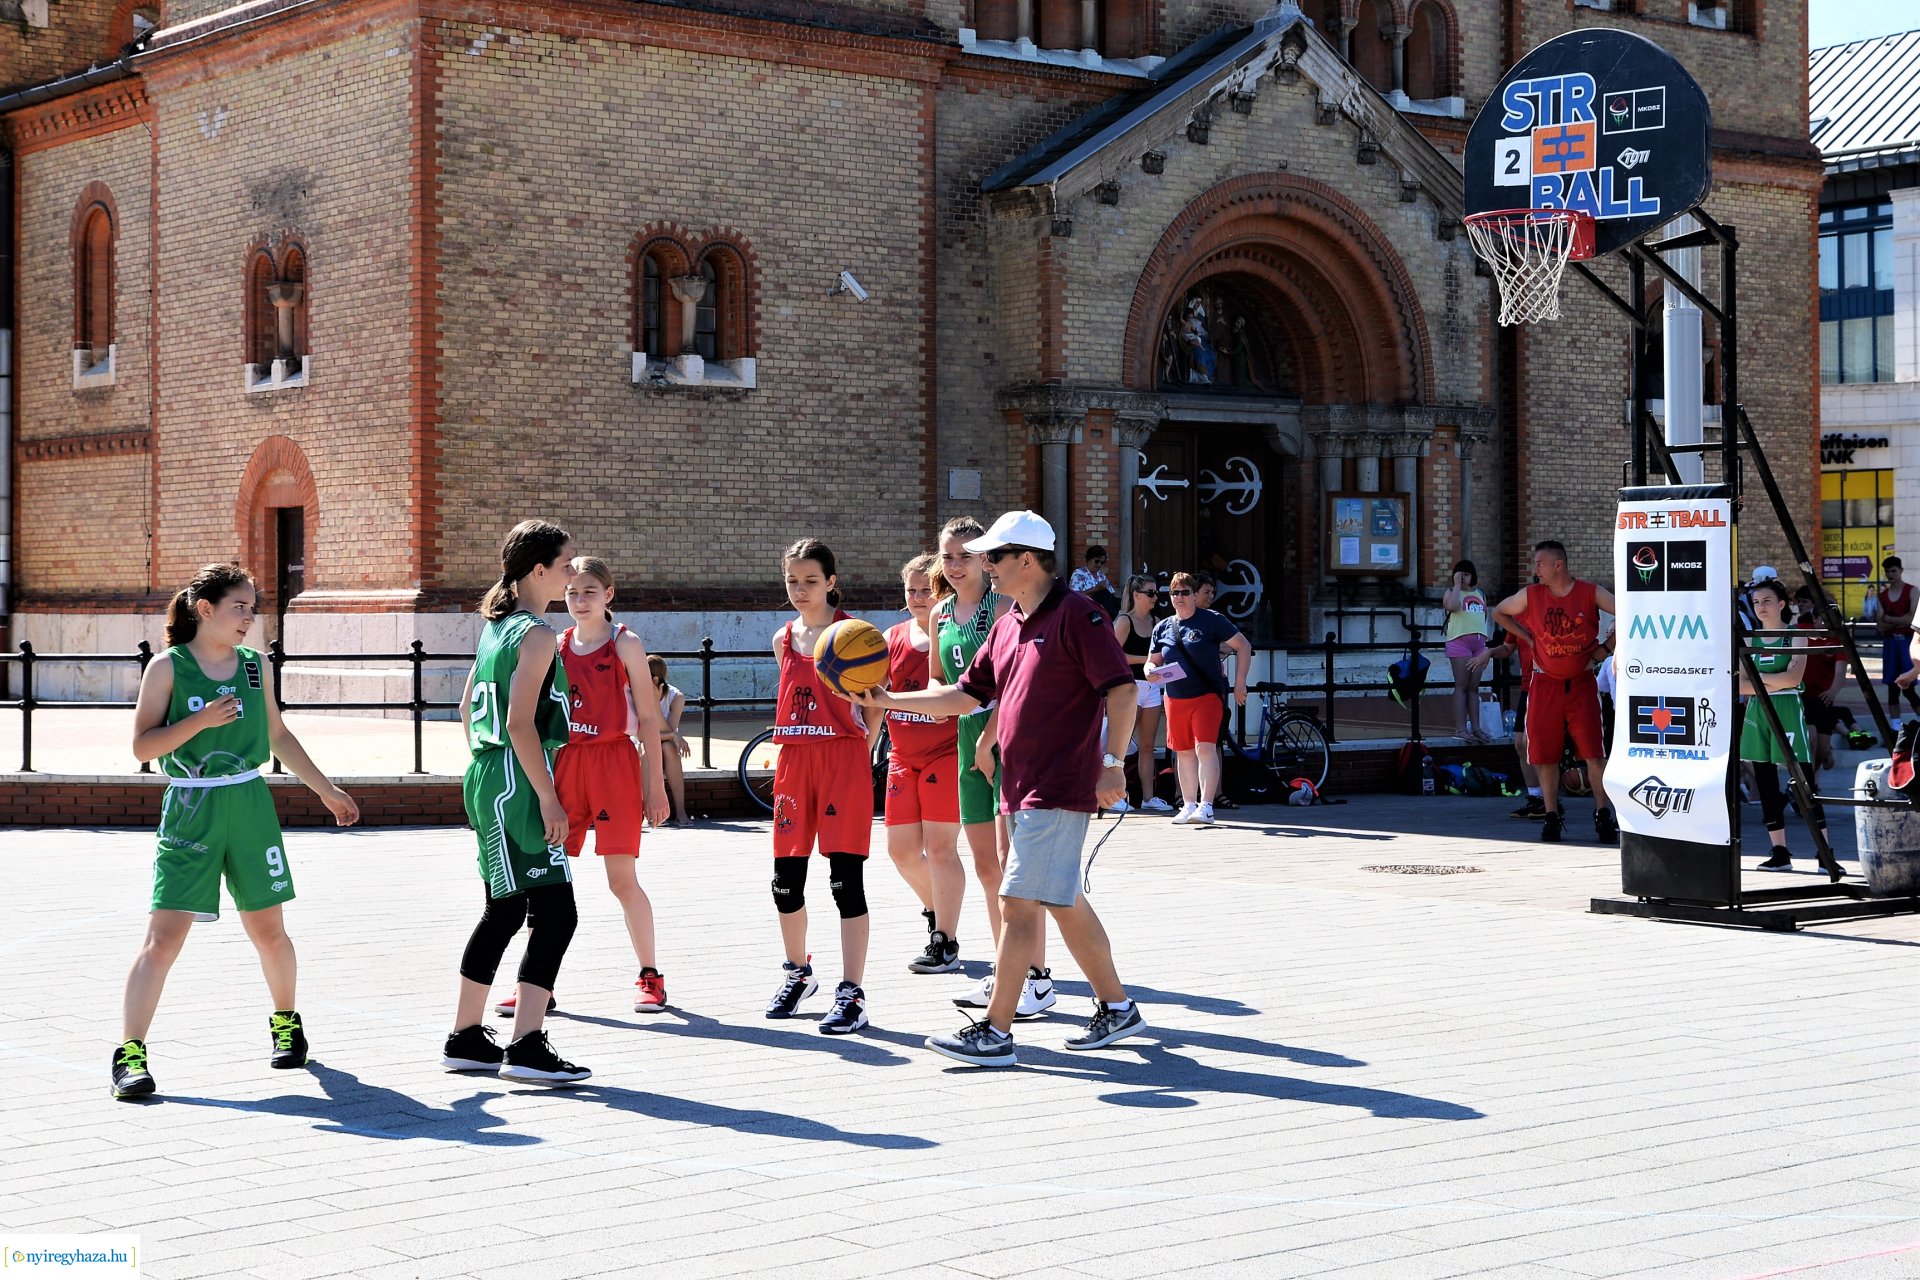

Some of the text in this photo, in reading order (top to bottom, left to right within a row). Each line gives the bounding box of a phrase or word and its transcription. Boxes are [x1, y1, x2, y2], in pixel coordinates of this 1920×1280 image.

[1501, 72, 1597, 132] STR
[1504, 149, 1521, 175] 2
[1531, 166, 1660, 222] BALL
[1629, 615, 1709, 640] MVM
[952, 644, 965, 668] 9
[1628, 665, 1715, 675] GB GROSBASKET
[471, 681, 501, 742] 21
[1638, 784, 1696, 814] TOTI
[265, 845, 285, 877] 9
